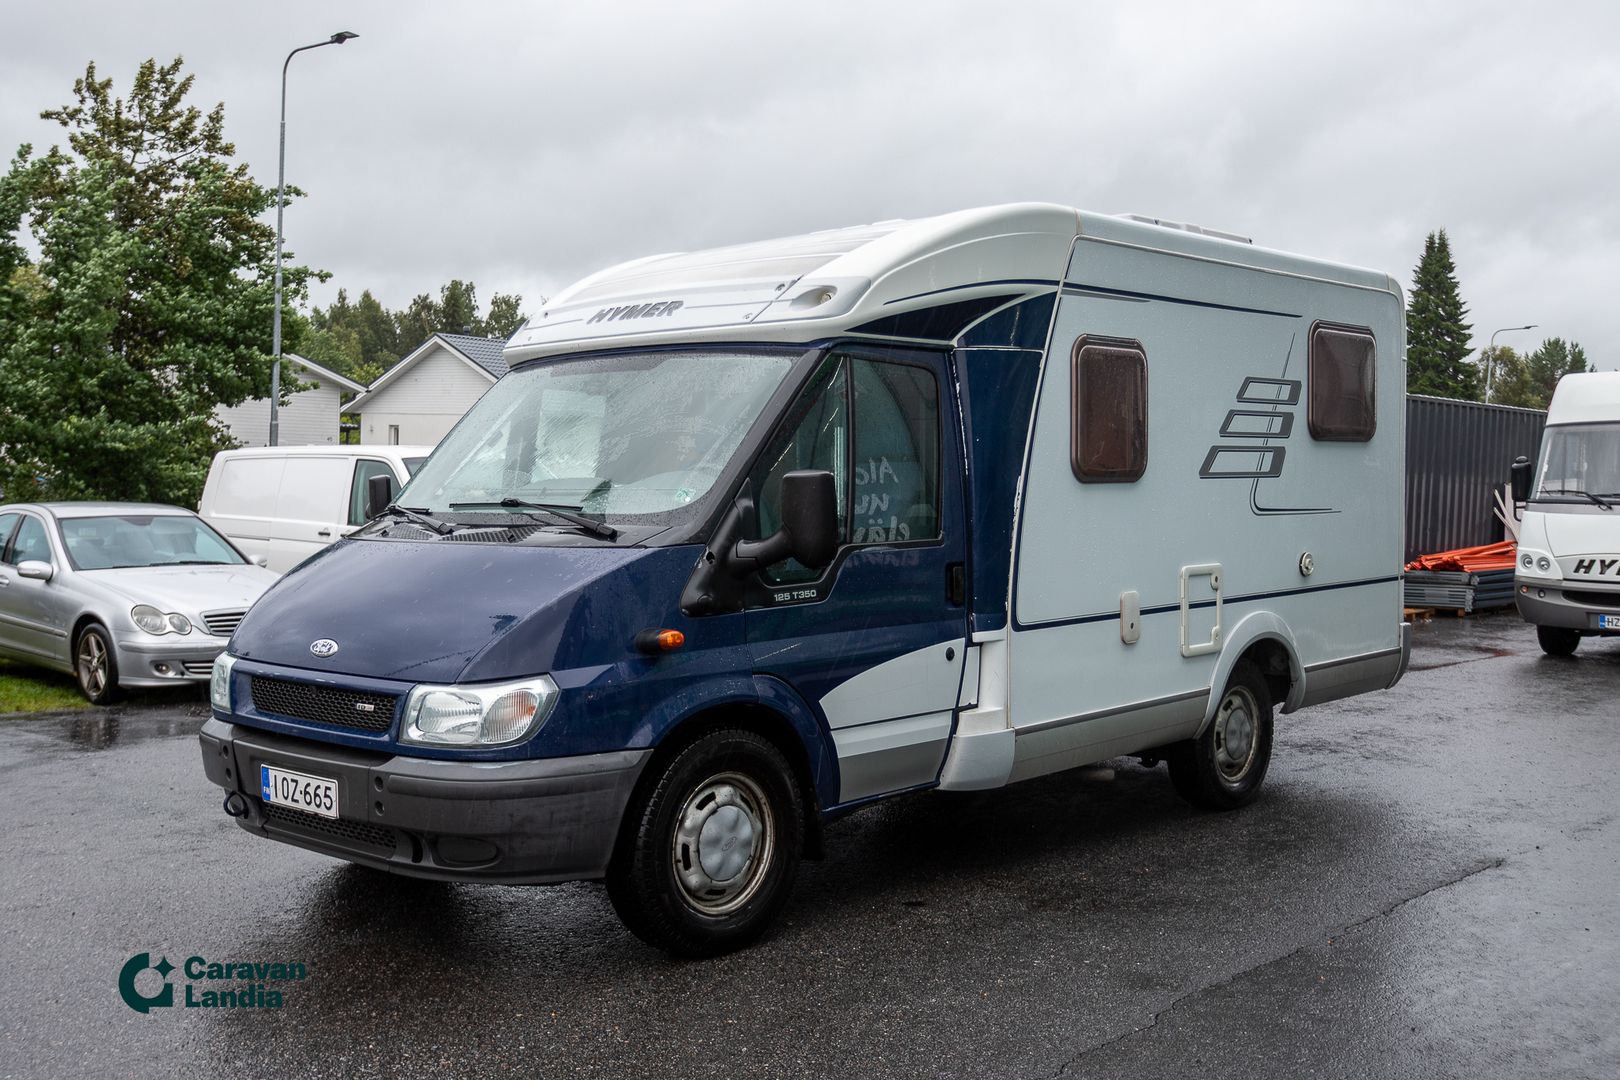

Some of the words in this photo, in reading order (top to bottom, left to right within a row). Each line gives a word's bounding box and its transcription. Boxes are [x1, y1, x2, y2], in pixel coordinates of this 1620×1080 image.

[586, 300, 684, 325] HYMER
[1573, 558, 1620, 576] HY
[774, 592, 791, 602] 125
[792, 589, 817, 600] T350
[273, 774, 334, 811] IOZ-665
